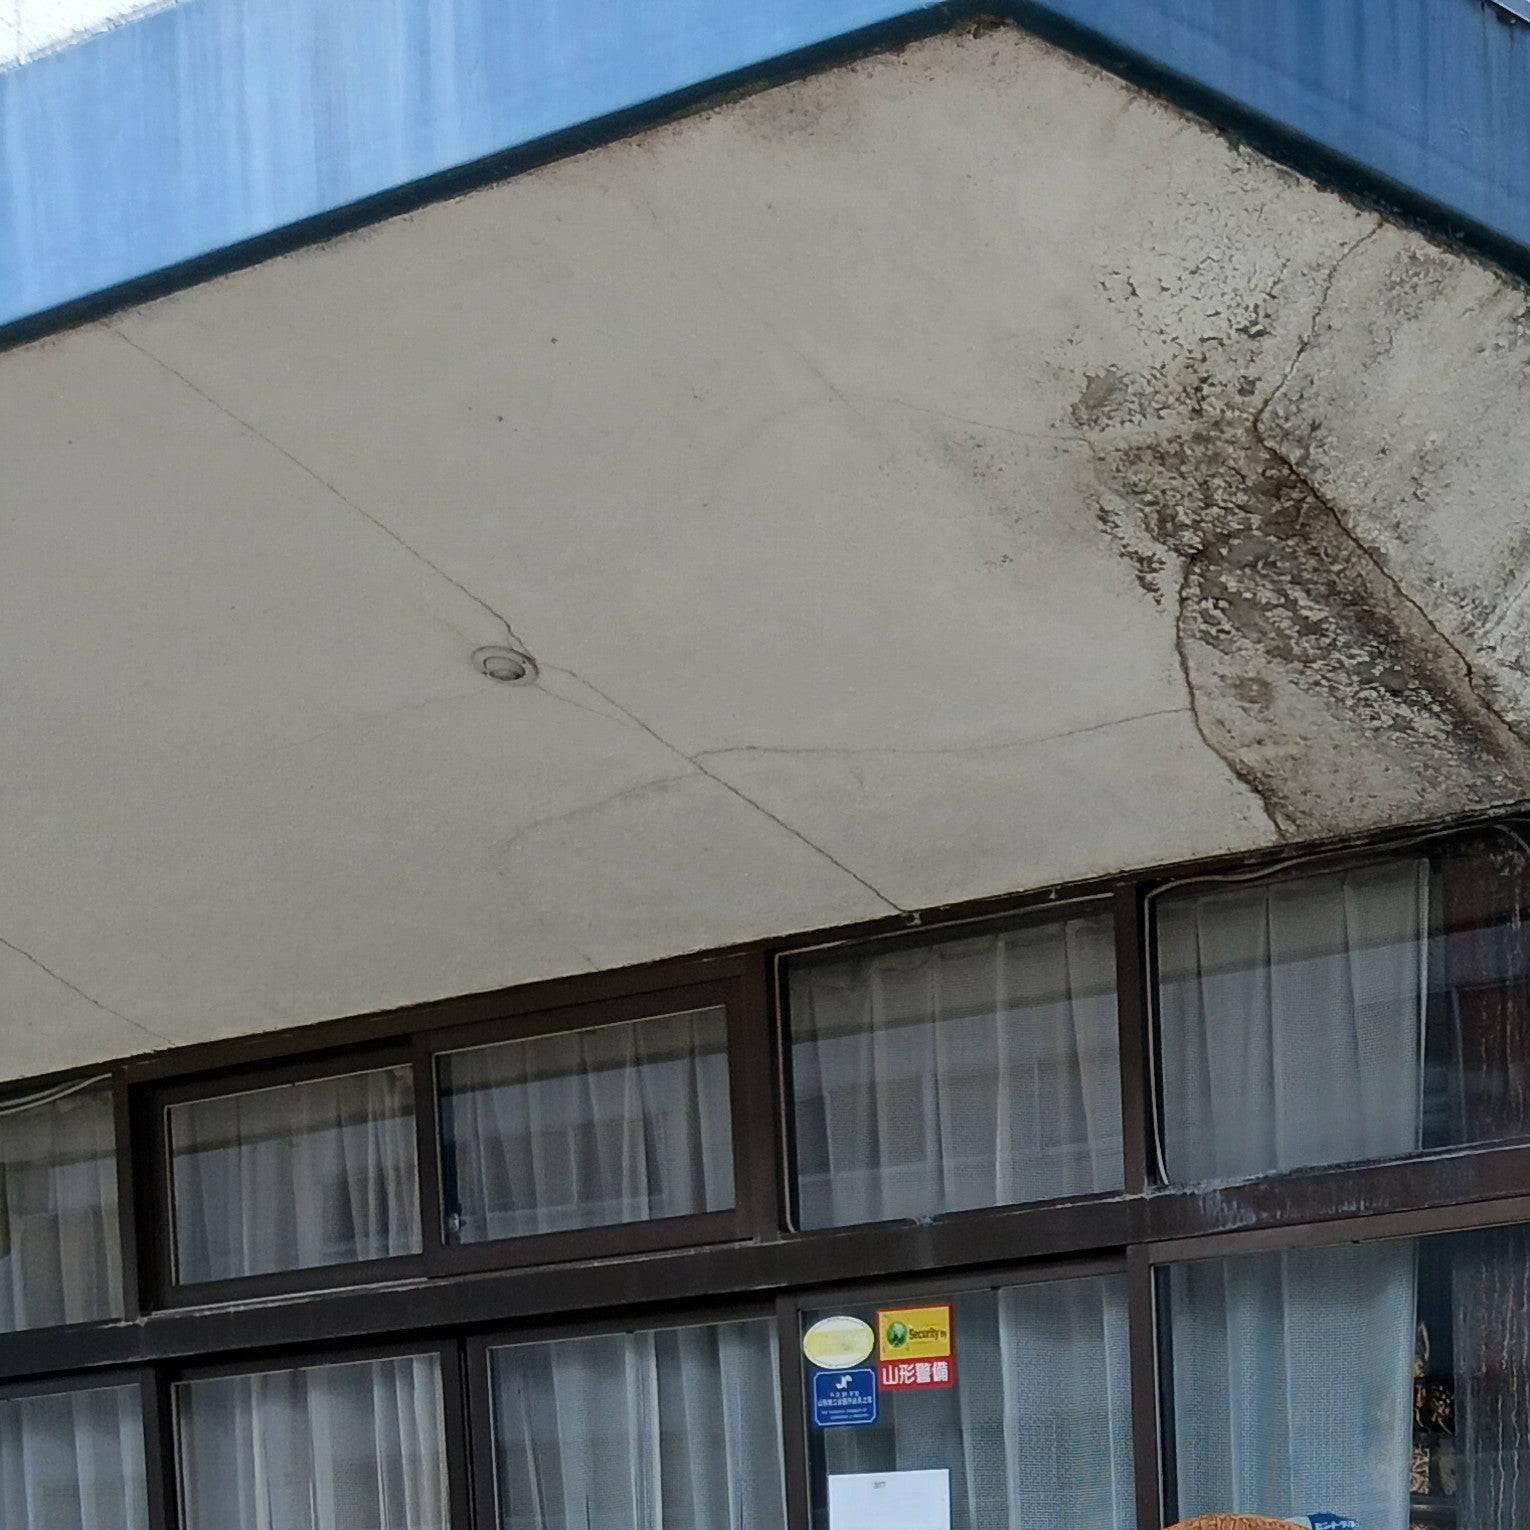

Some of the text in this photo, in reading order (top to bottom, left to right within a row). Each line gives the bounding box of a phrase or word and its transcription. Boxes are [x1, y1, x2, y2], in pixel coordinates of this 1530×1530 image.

[909, 1327, 940, 1341] Security
[882, 1361, 949, 1385] 山形警備
